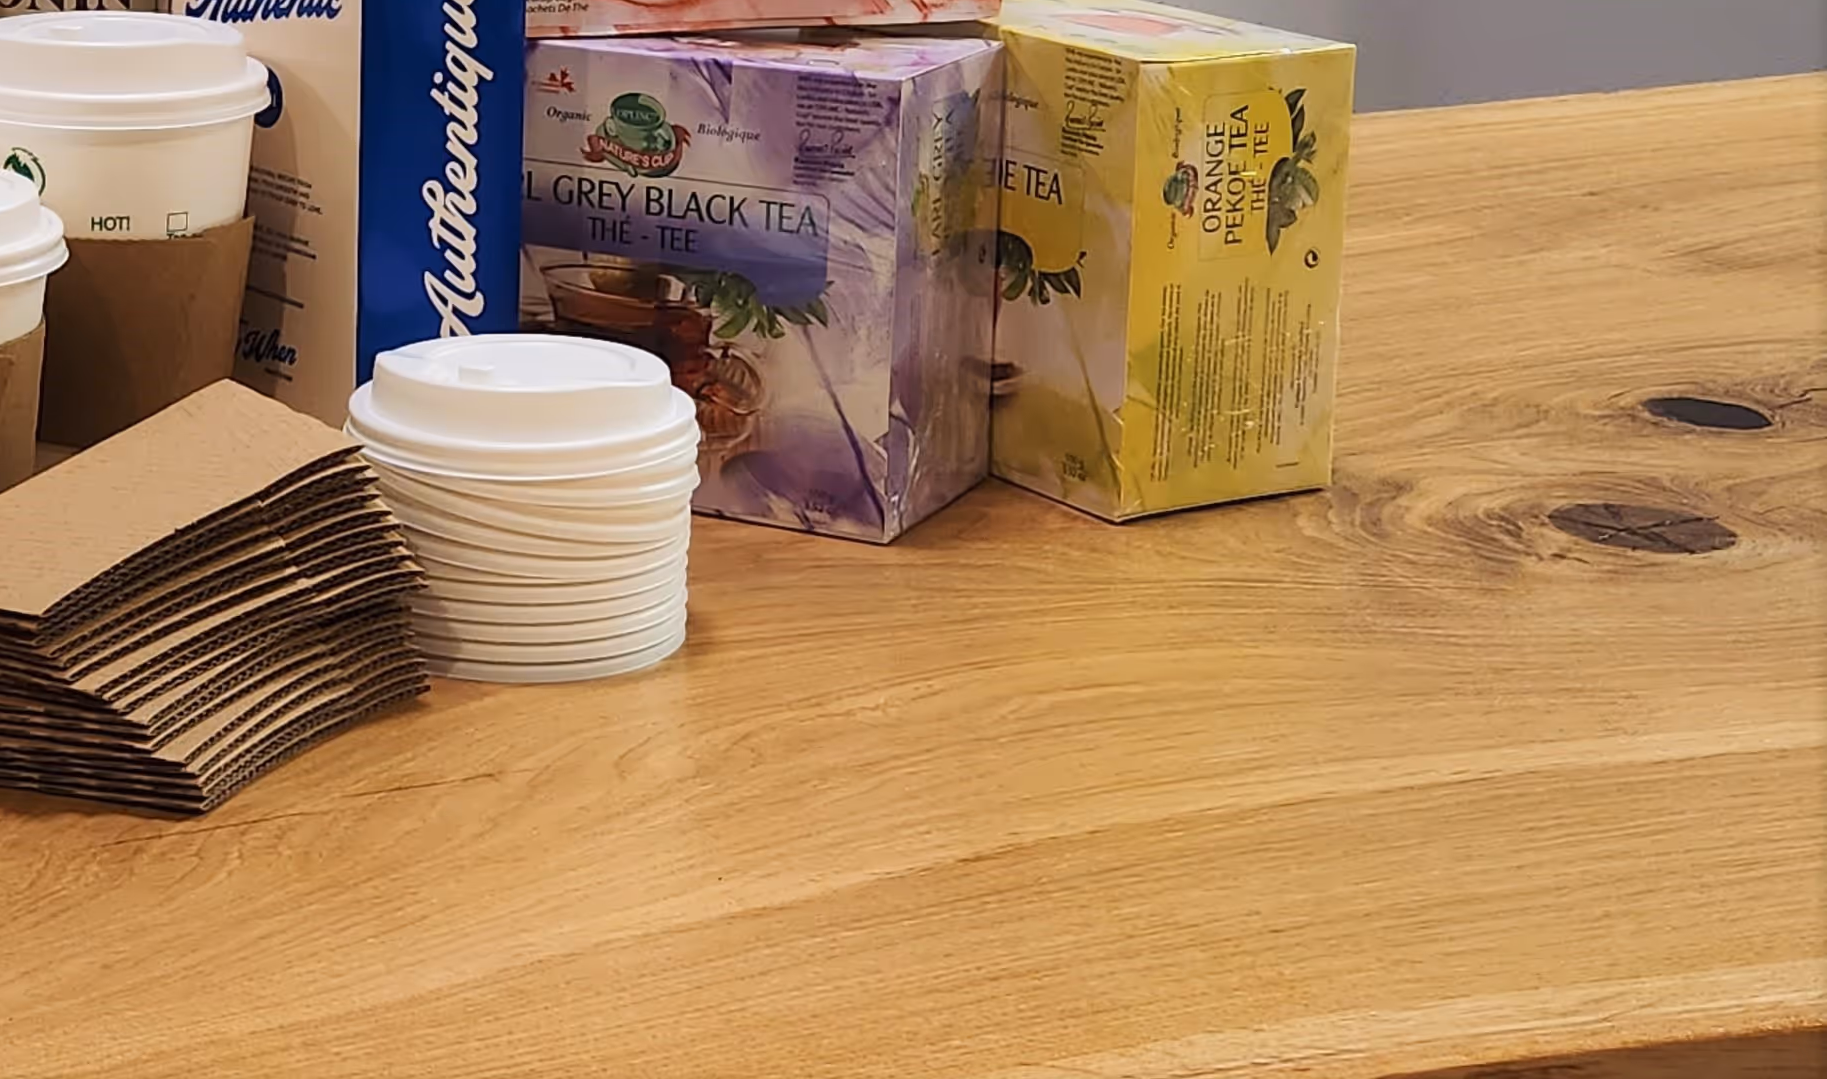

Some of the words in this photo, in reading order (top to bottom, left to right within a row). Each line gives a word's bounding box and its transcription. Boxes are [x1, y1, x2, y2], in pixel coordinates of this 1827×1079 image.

[546, 105, 592, 122] Organic
[696, 122, 762, 143] Biologique
[1229, 105, 1249, 154] TEA
[598, 138, 651, 168] NATURE'S
[651, 152, 675, 168] CUP
[1253, 122, 1270, 158] TEE
[1023, 164, 1063, 206] TEA
[1202, 122, 1225, 233] ORANGE
[553, 174, 634, 212] GREY
[644, 185, 749, 228] BLACK
[759, 199, 820, 237] TEA
[1225, 161, 1246, 245] PEKOE
[90, 216, 131, 232] HOT!
[587, 213, 632, 245] THÉ
[655, 228, 700, 253] TEE
